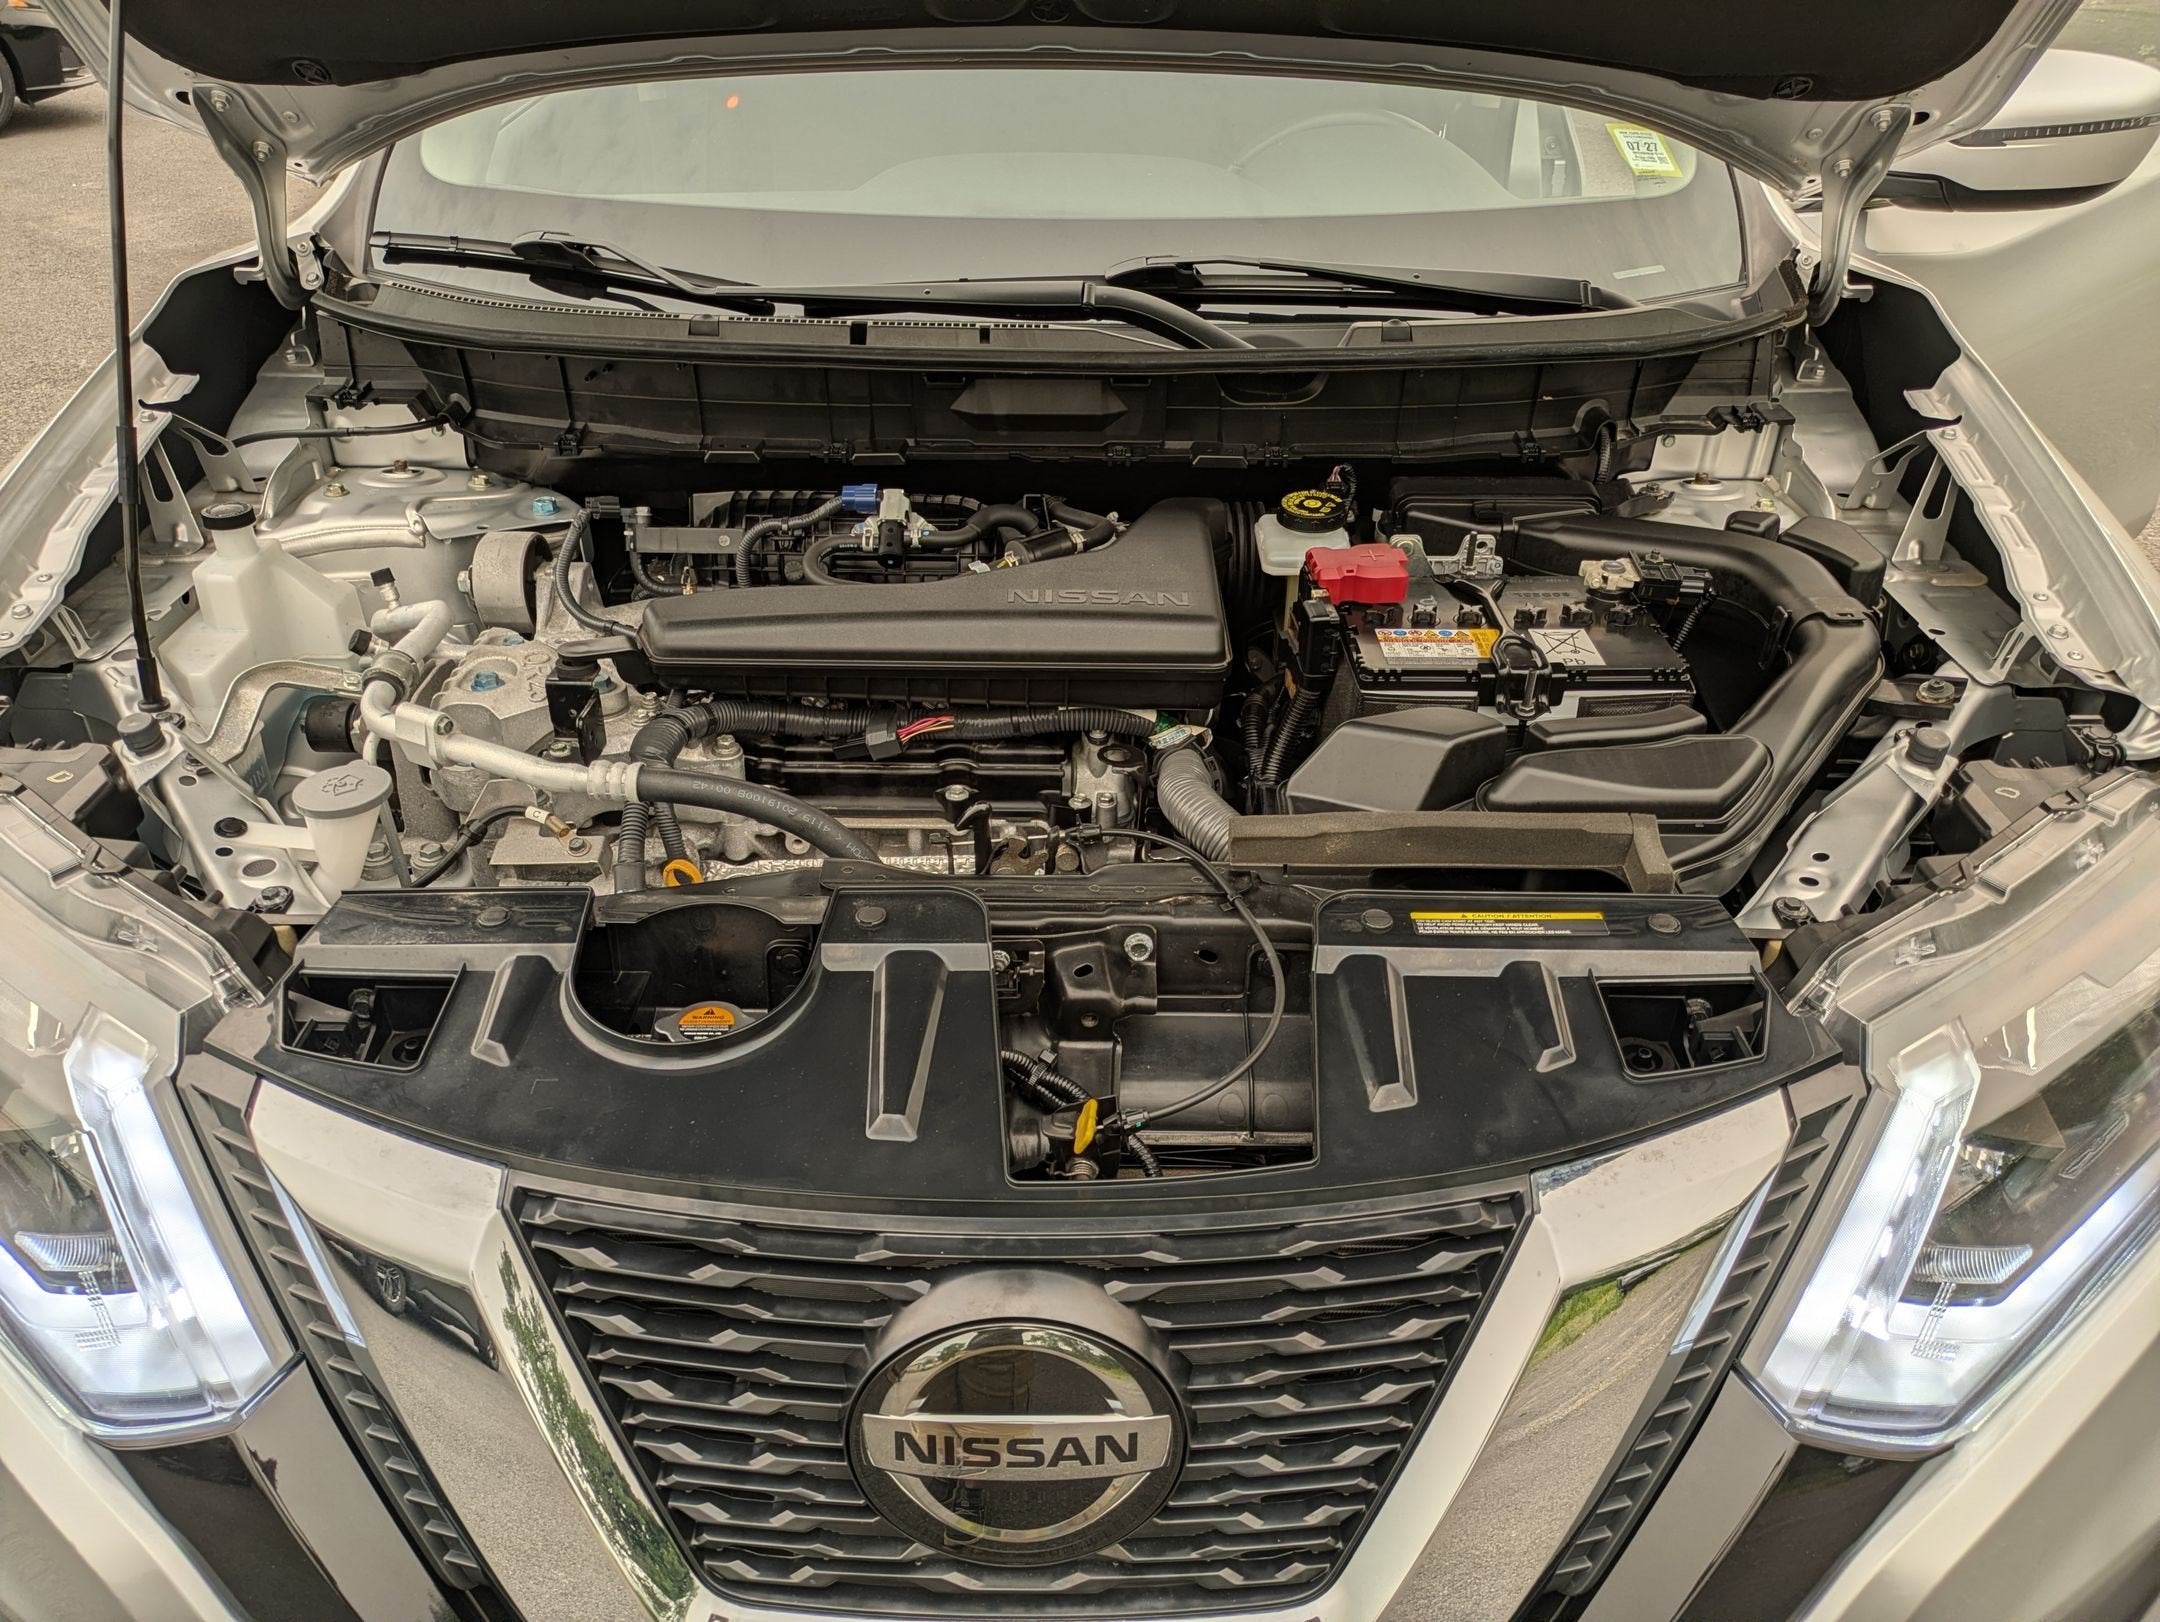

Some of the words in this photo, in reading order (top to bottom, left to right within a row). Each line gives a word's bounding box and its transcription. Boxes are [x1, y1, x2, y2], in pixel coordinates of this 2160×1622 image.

[1626, 142, 1641, 151] 07
[1644, 142, 1658, 152] 27
[1007, 589, 1190, 607] NISSAN
[1562, 657, 1586, 666] Pb
[893, 1430, 1139, 1469] NISSAN
